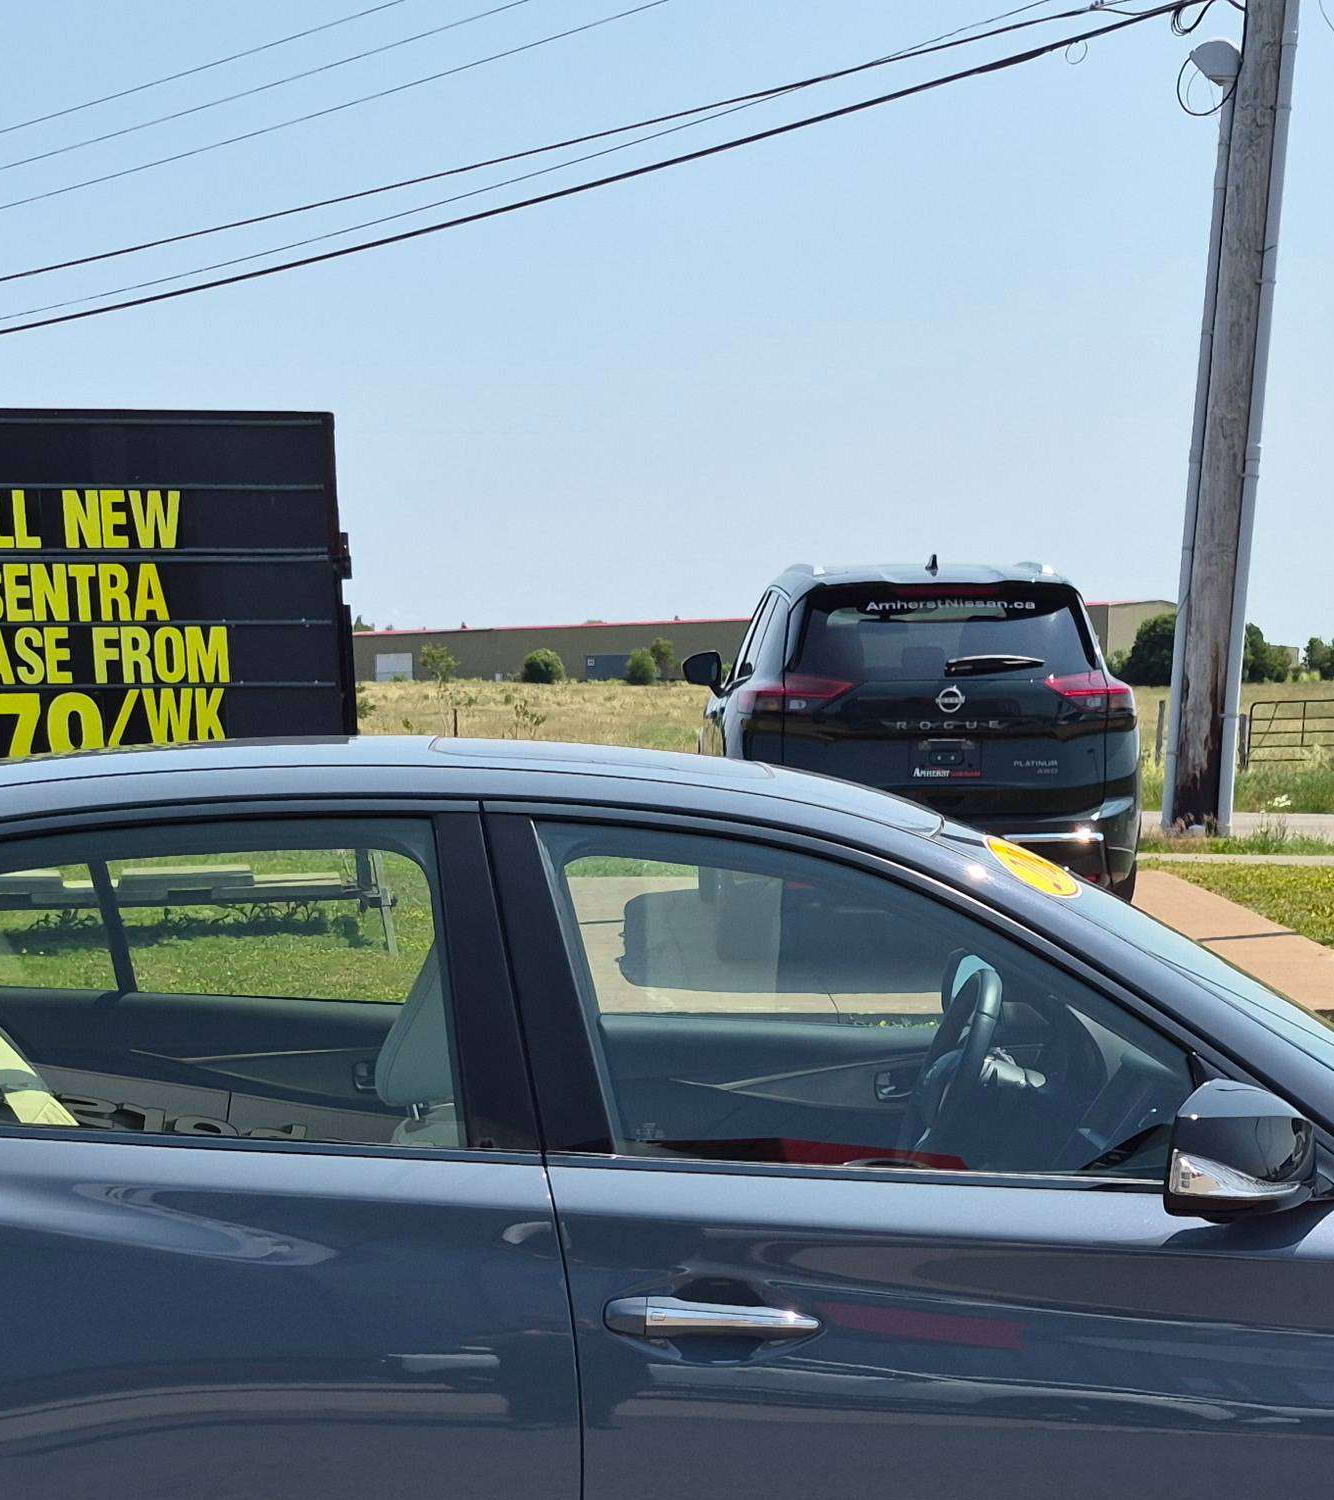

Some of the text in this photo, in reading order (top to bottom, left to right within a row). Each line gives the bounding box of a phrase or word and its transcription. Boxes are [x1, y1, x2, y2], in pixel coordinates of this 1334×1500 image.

[62, 489, 181, 549] NEW
[866, 598, 1035, 612] AmherstNissan.ca
[92, 625, 230, 684] FROM
[896, 720, 1004, 730] ROGUE
